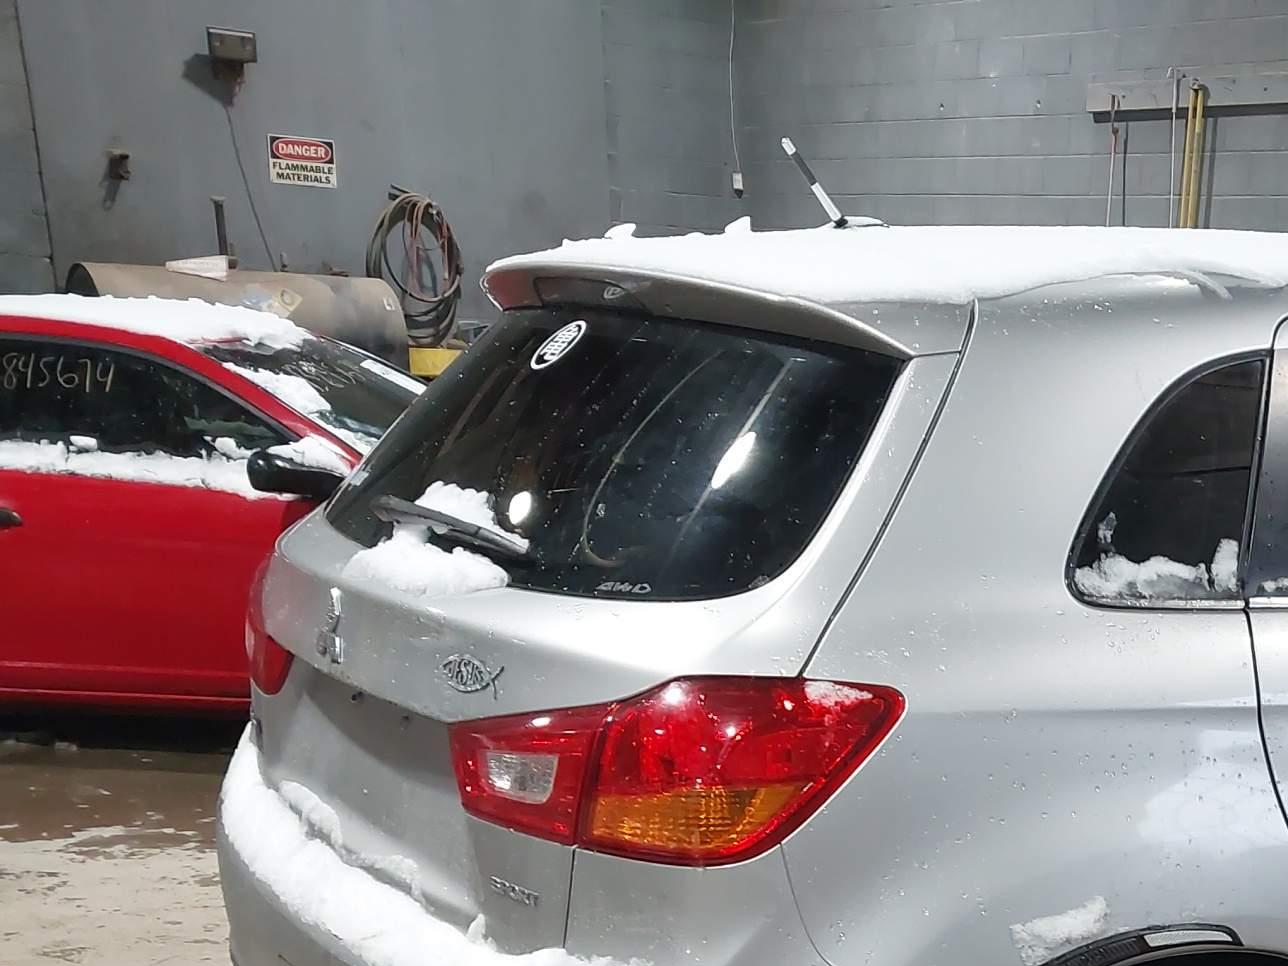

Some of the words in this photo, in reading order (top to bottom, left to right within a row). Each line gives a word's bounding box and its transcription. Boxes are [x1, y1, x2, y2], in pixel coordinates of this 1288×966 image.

[278, 143, 326, 158] DANGER
[272, 161, 334, 175] FLAMMABLE
[276, 172, 331, 184] MATERIALS
[2, 352, 115, 392] 845674
[595, 582, 652, 593] AWD
[489, 876, 540, 908] SPORT
